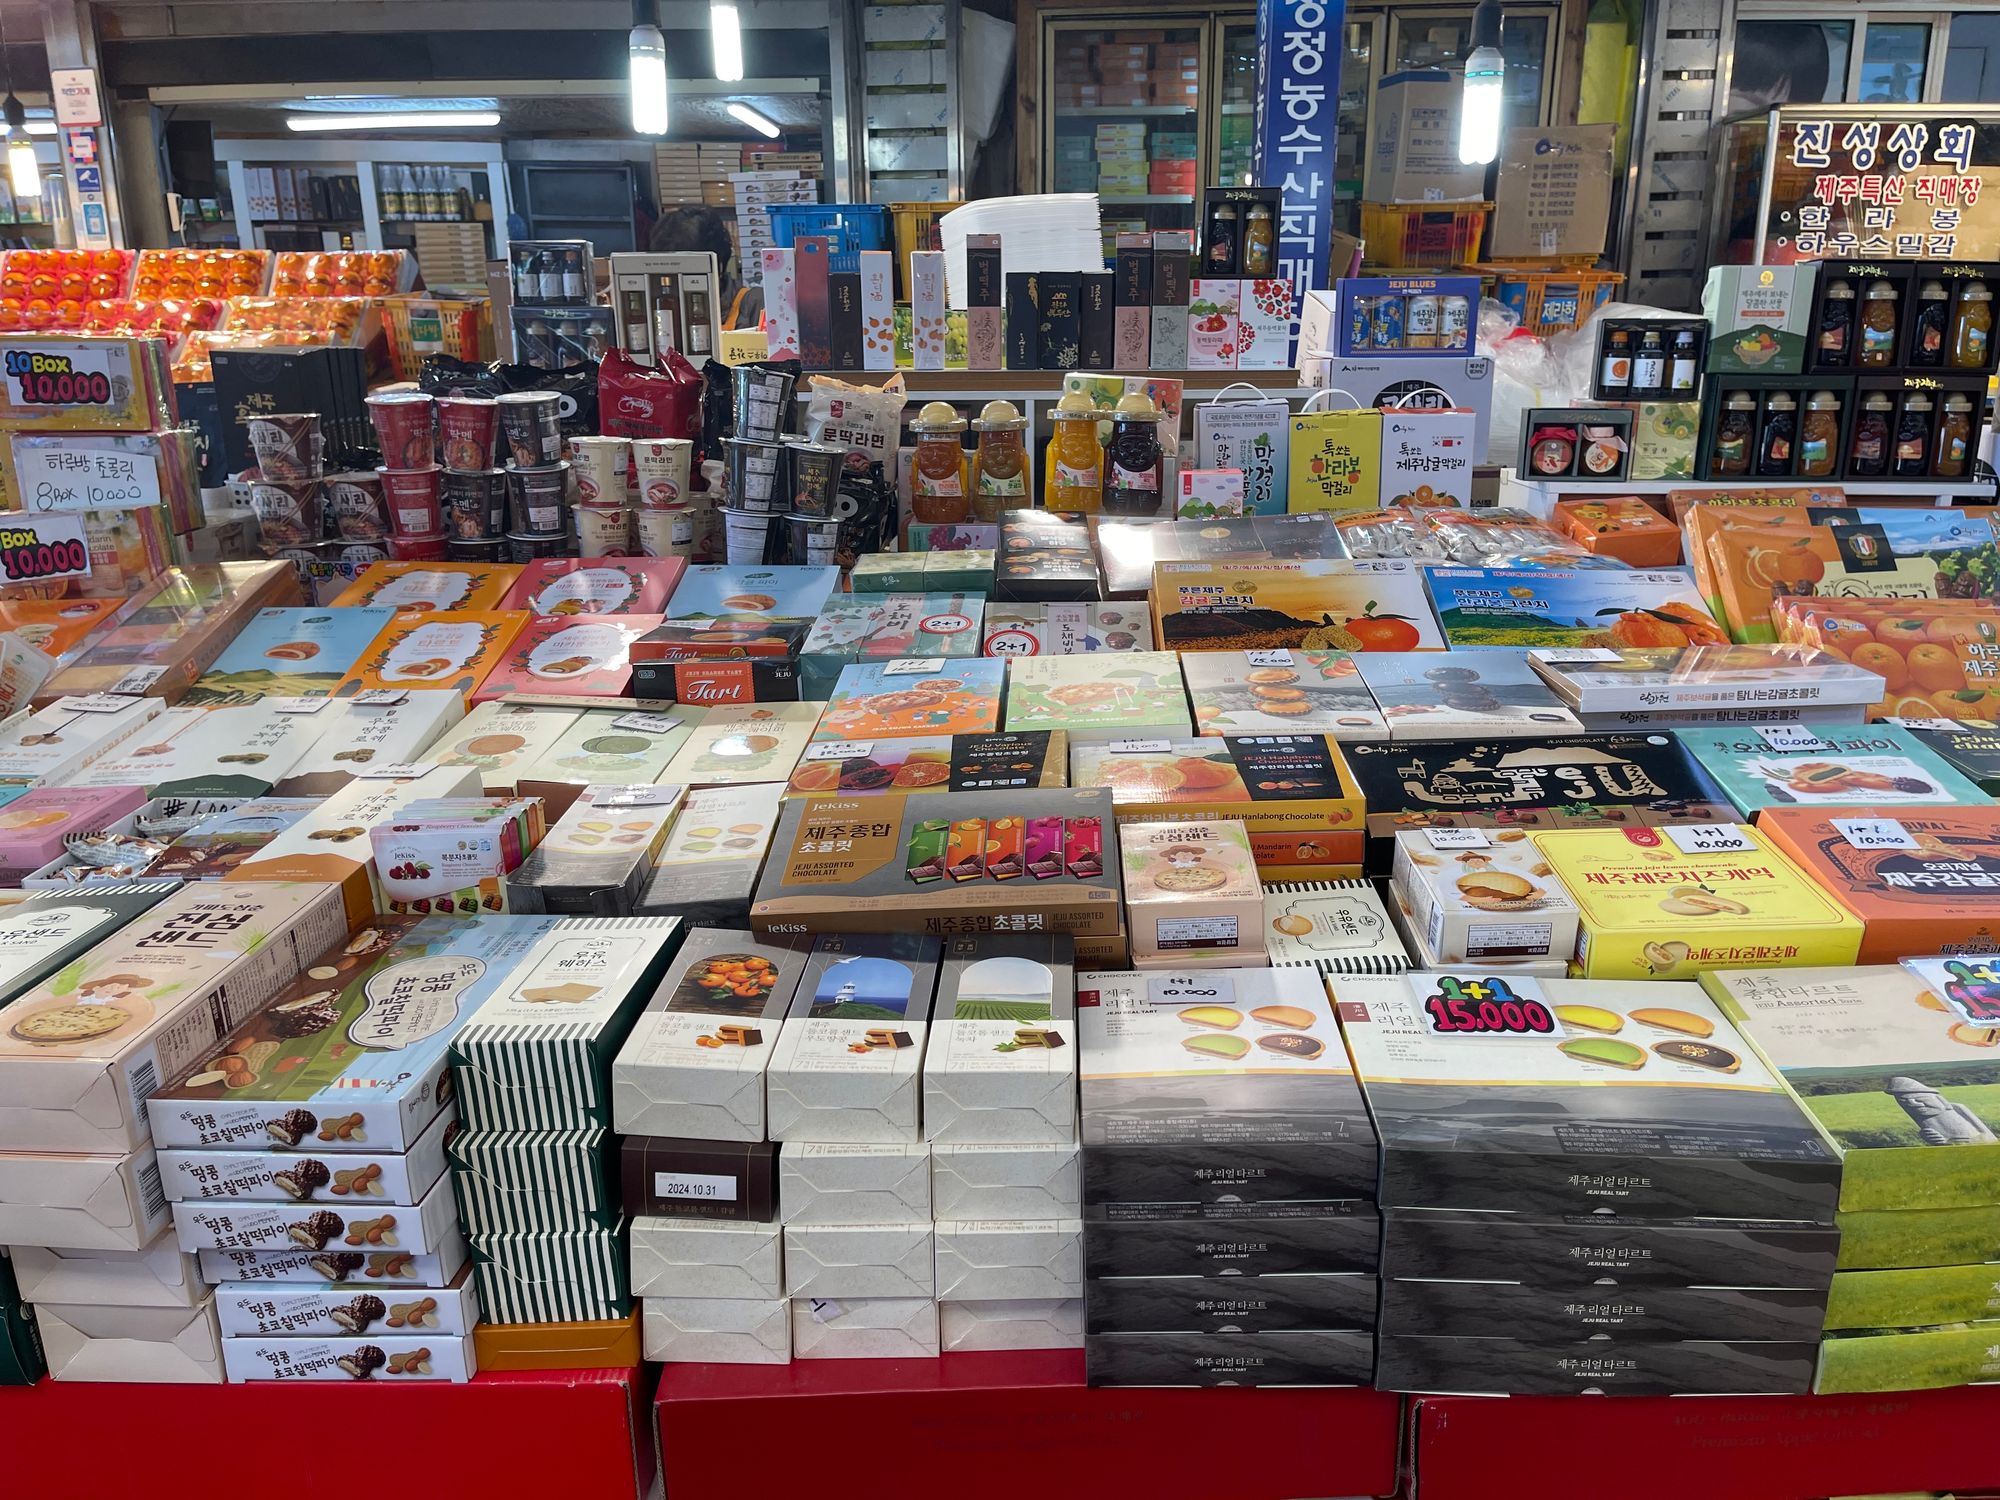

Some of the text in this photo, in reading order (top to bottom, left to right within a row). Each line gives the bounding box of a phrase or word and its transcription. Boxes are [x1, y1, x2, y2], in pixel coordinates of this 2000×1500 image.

[1794, 120, 1976, 174] 진성상회
[1814, 174, 1983, 207] 제주특산 직매장
[1795, 231, 1958, 258] 하우스밀감
[1409, 280, 1437, 288] BLUES
[824, 427, 885, 449] 문딱라면
[644, 456, 673, 464] 문딱라면
[1254, 445, 1275, 502] 막걸리
[1310, 454, 1362, 485] 한라봉
[1322, 480, 1352, 498] 막걸리
[995, 641, 1027, 652] 2+1
[774, 671, 792, 679] JEJU
[1963, 659, 1998, 677] 제주
[686, 679, 743, 702] Tart
[1736, 687, 1820, 701] 탐나는감귤초콜릿
[1716, 709, 1800, 721] 탐나는감귤초콜릿
[1240, 813, 1284, 822] Hanlabong
[1284, 812, 1325, 820] Chocolate
[804, 823, 893, 840] 제주종합
[1693, 827, 1725, 837] 1+1
[798, 839, 853, 853] 초콜릿
[1257, 843, 1292, 851] Mandarin
[791, 868, 839, 878] CHOCOLATE
[793, 861, 855, 871] JEJU ASSORTED
[1922, 861, 1985, 872] 오리지널
[1581, 866, 1776, 886] 제주레몬치즈케익
[162, 912, 254, 931] 진심
[1052, 911, 1104, 921] JEJU ASSORTED
[1052, 919, 1092, 930] CHOCOLATE
[135, 930, 230, 949] 샌드
[1440, 976, 1511, 1001] 1+1
[1735, 975, 1779, 988] 제주
[1104, 988, 1136, 997] 제주
[1743, 984, 1858, 1001] 종합타르트
[1105, 999, 1136, 1008] 리얼
[1370, 1000, 1410, 1013] 제주
[1776, 997, 1838, 1008] Assorted
[1377, 1013, 1419, 1027] 리얼
[1428, 998, 1551, 1033] 15.000
[189, 1114, 218, 1132] 땅콩
[199, 1120, 267, 1146] 초코찰떡파이
[190, 1164, 219, 1184] 땅콩
[200, 1170, 277, 1199] 초코찰떡파이
[667, 1181, 717, 1197] 2024.10.31
[204, 1216, 233, 1235] 땅콩
[214, 1222, 290, 1250] 초코찰떡파이
[229, 1251, 257, 1266] 땅콩
[238, 1255, 312, 1282] 초코찰떡파이
[248, 1301, 277, 1320] 땅콩
[258, 1305, 333, 1334] 초코찰떡파이
[264, 1350, 291, 1367] 땅콩
[273, 1355, 339, 1380] 초코찰떡파이
